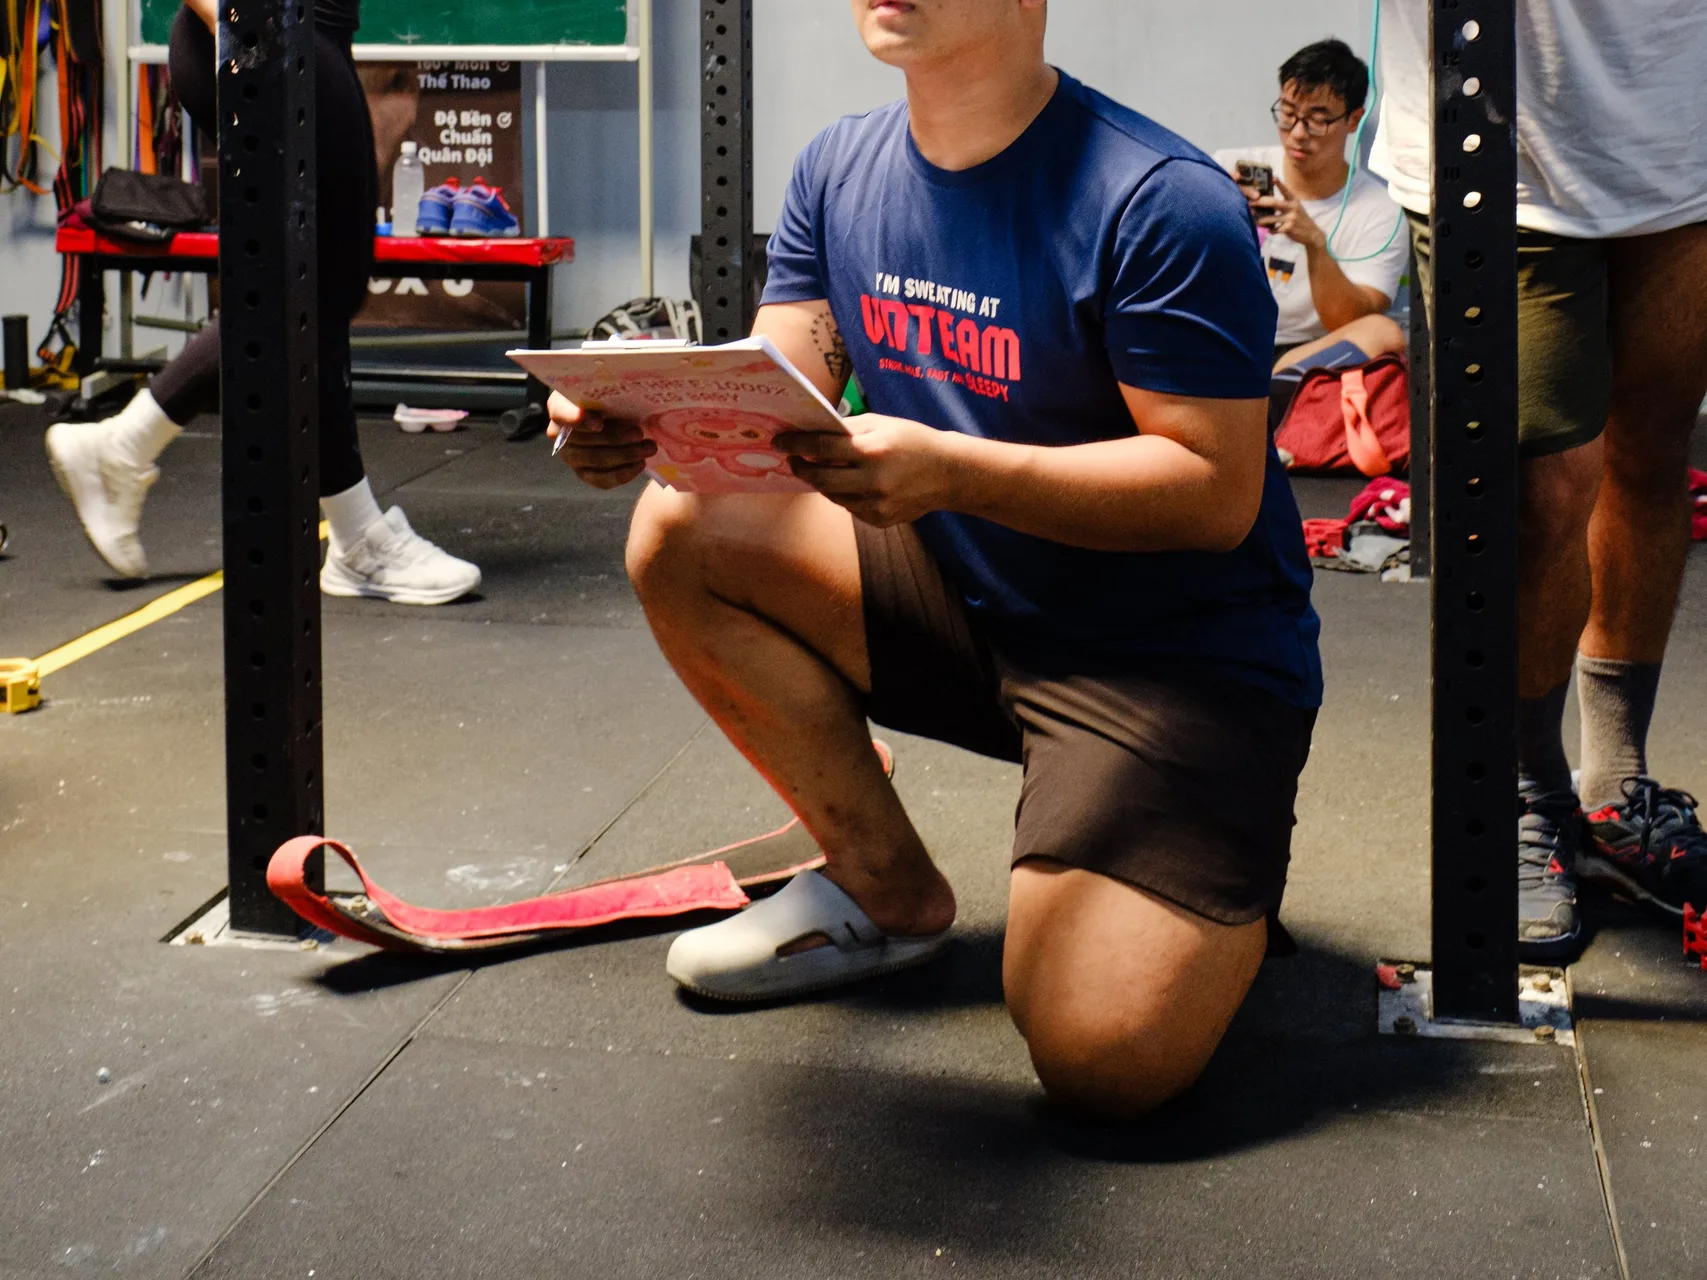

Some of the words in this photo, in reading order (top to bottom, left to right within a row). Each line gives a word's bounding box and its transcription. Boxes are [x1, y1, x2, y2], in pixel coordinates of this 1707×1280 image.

[1443, 51, 1460, 66] 12
[451, 74, 491, 89] Thao
[434, 109, 457, 128] Độ
[418, 146, 462, 165] Quân
[465, 147, 493, 167] Đội
[904, 277, 976, 314] SWEATING
[979, 296, 1000, 318] AT
